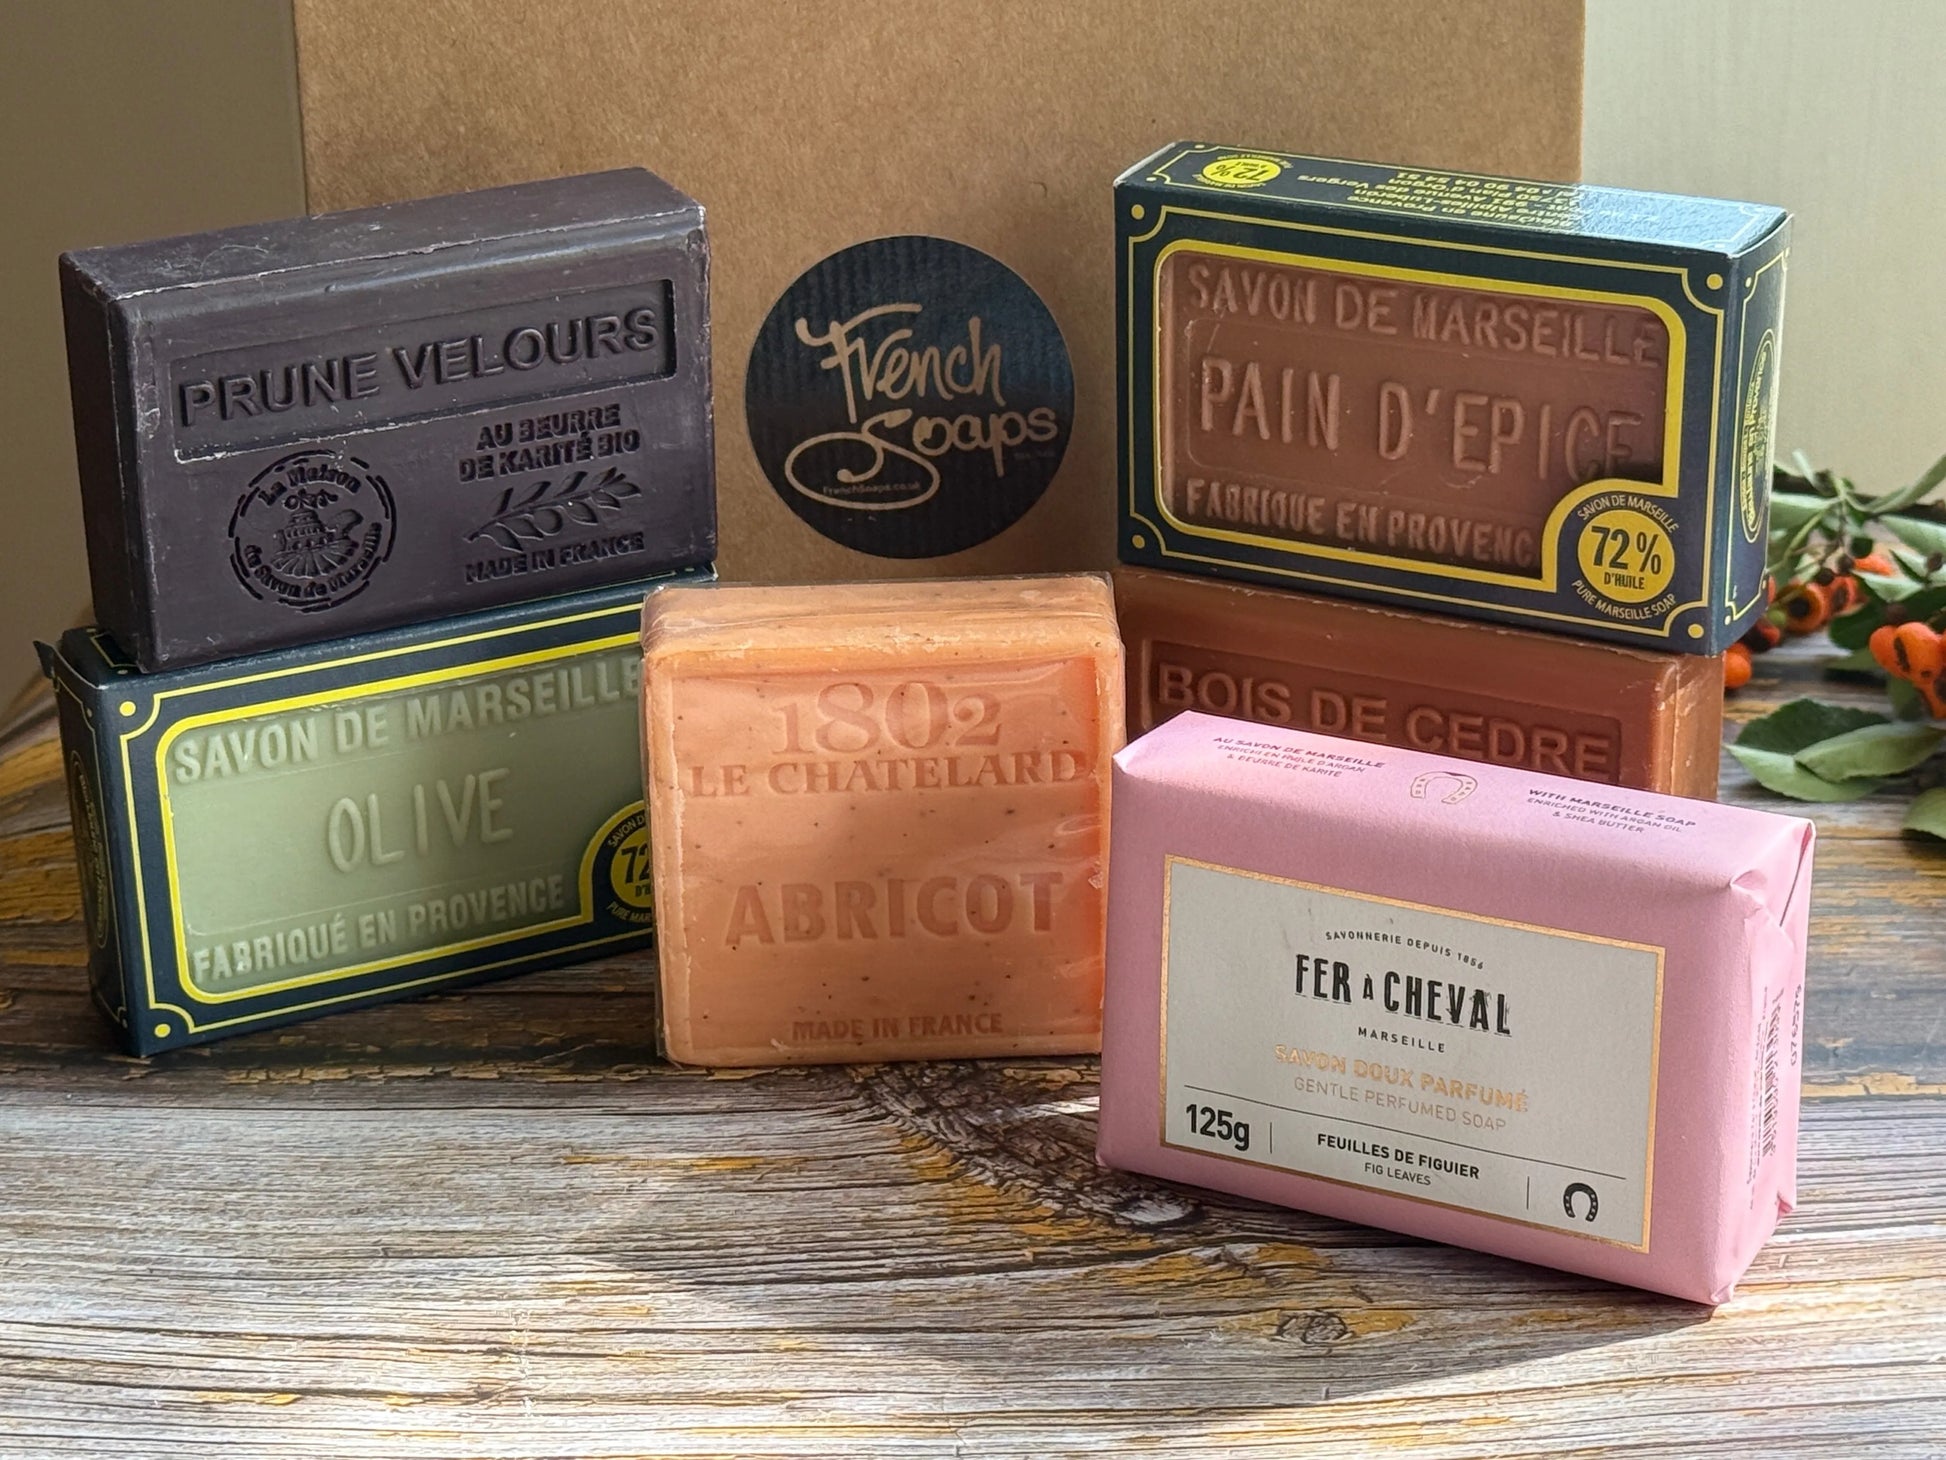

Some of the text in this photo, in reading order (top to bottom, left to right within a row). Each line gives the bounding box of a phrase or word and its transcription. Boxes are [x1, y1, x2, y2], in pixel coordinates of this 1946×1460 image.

[1297, 175, 1369, 189] Vergers
[1346, 195, 1437, 212] Provence
[1374, 184, 1410, 193] des
[1413, 187, 1487, 201] Avenue
[1188, 263, 1660, 368] SAVON DE MARSEILLE
[180, 308, 659, 427] PRUNE VELOURS
[795, 303, 1006, 424] French
[1200, 357, 1341, 450] PAIN
[476, 404, 621, 452] AU BEURRE
[459, 455, 495, 485] DE
[598, 430, 641, 459] BIO
[784, 407, 1059, 511] Soaps
[1336, 502, 1379, 544] EN
[1387, 510, 1535, 568] PROVENC
[1577, 494, 1679, 533] SAVON DE MARSEILLE
[465, 532, 645, 584] MADE IN FRANCE
[1604, 572, 1645, 590] D'HUILE
[1571, 580, 1677, 620] PURE MARSEILLE SOAP
[174, 655, 641, 785] SAVON DE MARSEILLE
[773, 680, 1002, 755] 1802
[1158, 662, 1291, 724] BOIS
[1311, 690, 1387, 742] DE
[1236, 740, 1281, 751] SAVON
[1283, 747, 1305, 755] DE
[1305, 750, 1386, 769] MARSEILLE
[1284, 763, 1301, 771] DE
[688, 764, 751, 798] LE
[328, 767, 513, 874] OLIVE
[1526, 798, 1587, 813] ENRICHED
[1589, 809, 1619, 820] WITH
[1620, 815, 1663, 828] ARGAN
[1529, 789, 1697, 827] WITH MARSEILLE SOAP
[1565, 813, 1596, 824] SHEA
[1597, 819, 1645, 833] BUTTER
[607, 817, 637, 848] SAVON
[621, 843, 650, 885] 72
[193, 875, 564, 982] FABRIQUÉ EN PROVENCE
[725, 872, 1064, 947] ABRICOT
[1325, 931, 1485, 970] SAVONNERIE DEPUIS 1856
[1294, 954, 1352, 1004] FER
[1384, 971, 1512, 1036] CHEVAL
[792, 1013, 1003, 1042] MADE IN FRANCE
[1358, 1026, 1446, 1053] MARSEILLE
[1274, 1044, 1529, 1113] SAVON DOUX PARFUMÉ
[1185, 1103, 1250, 1151] 125g
[1294, 1077, 1506, 1131] GENTLE PERFUMED SOAP
[1317, 1133, 1480, 1180] FEUILLES DE FIGUIER
[1364, 1162, 1432, 1186] FIG LEAVES
